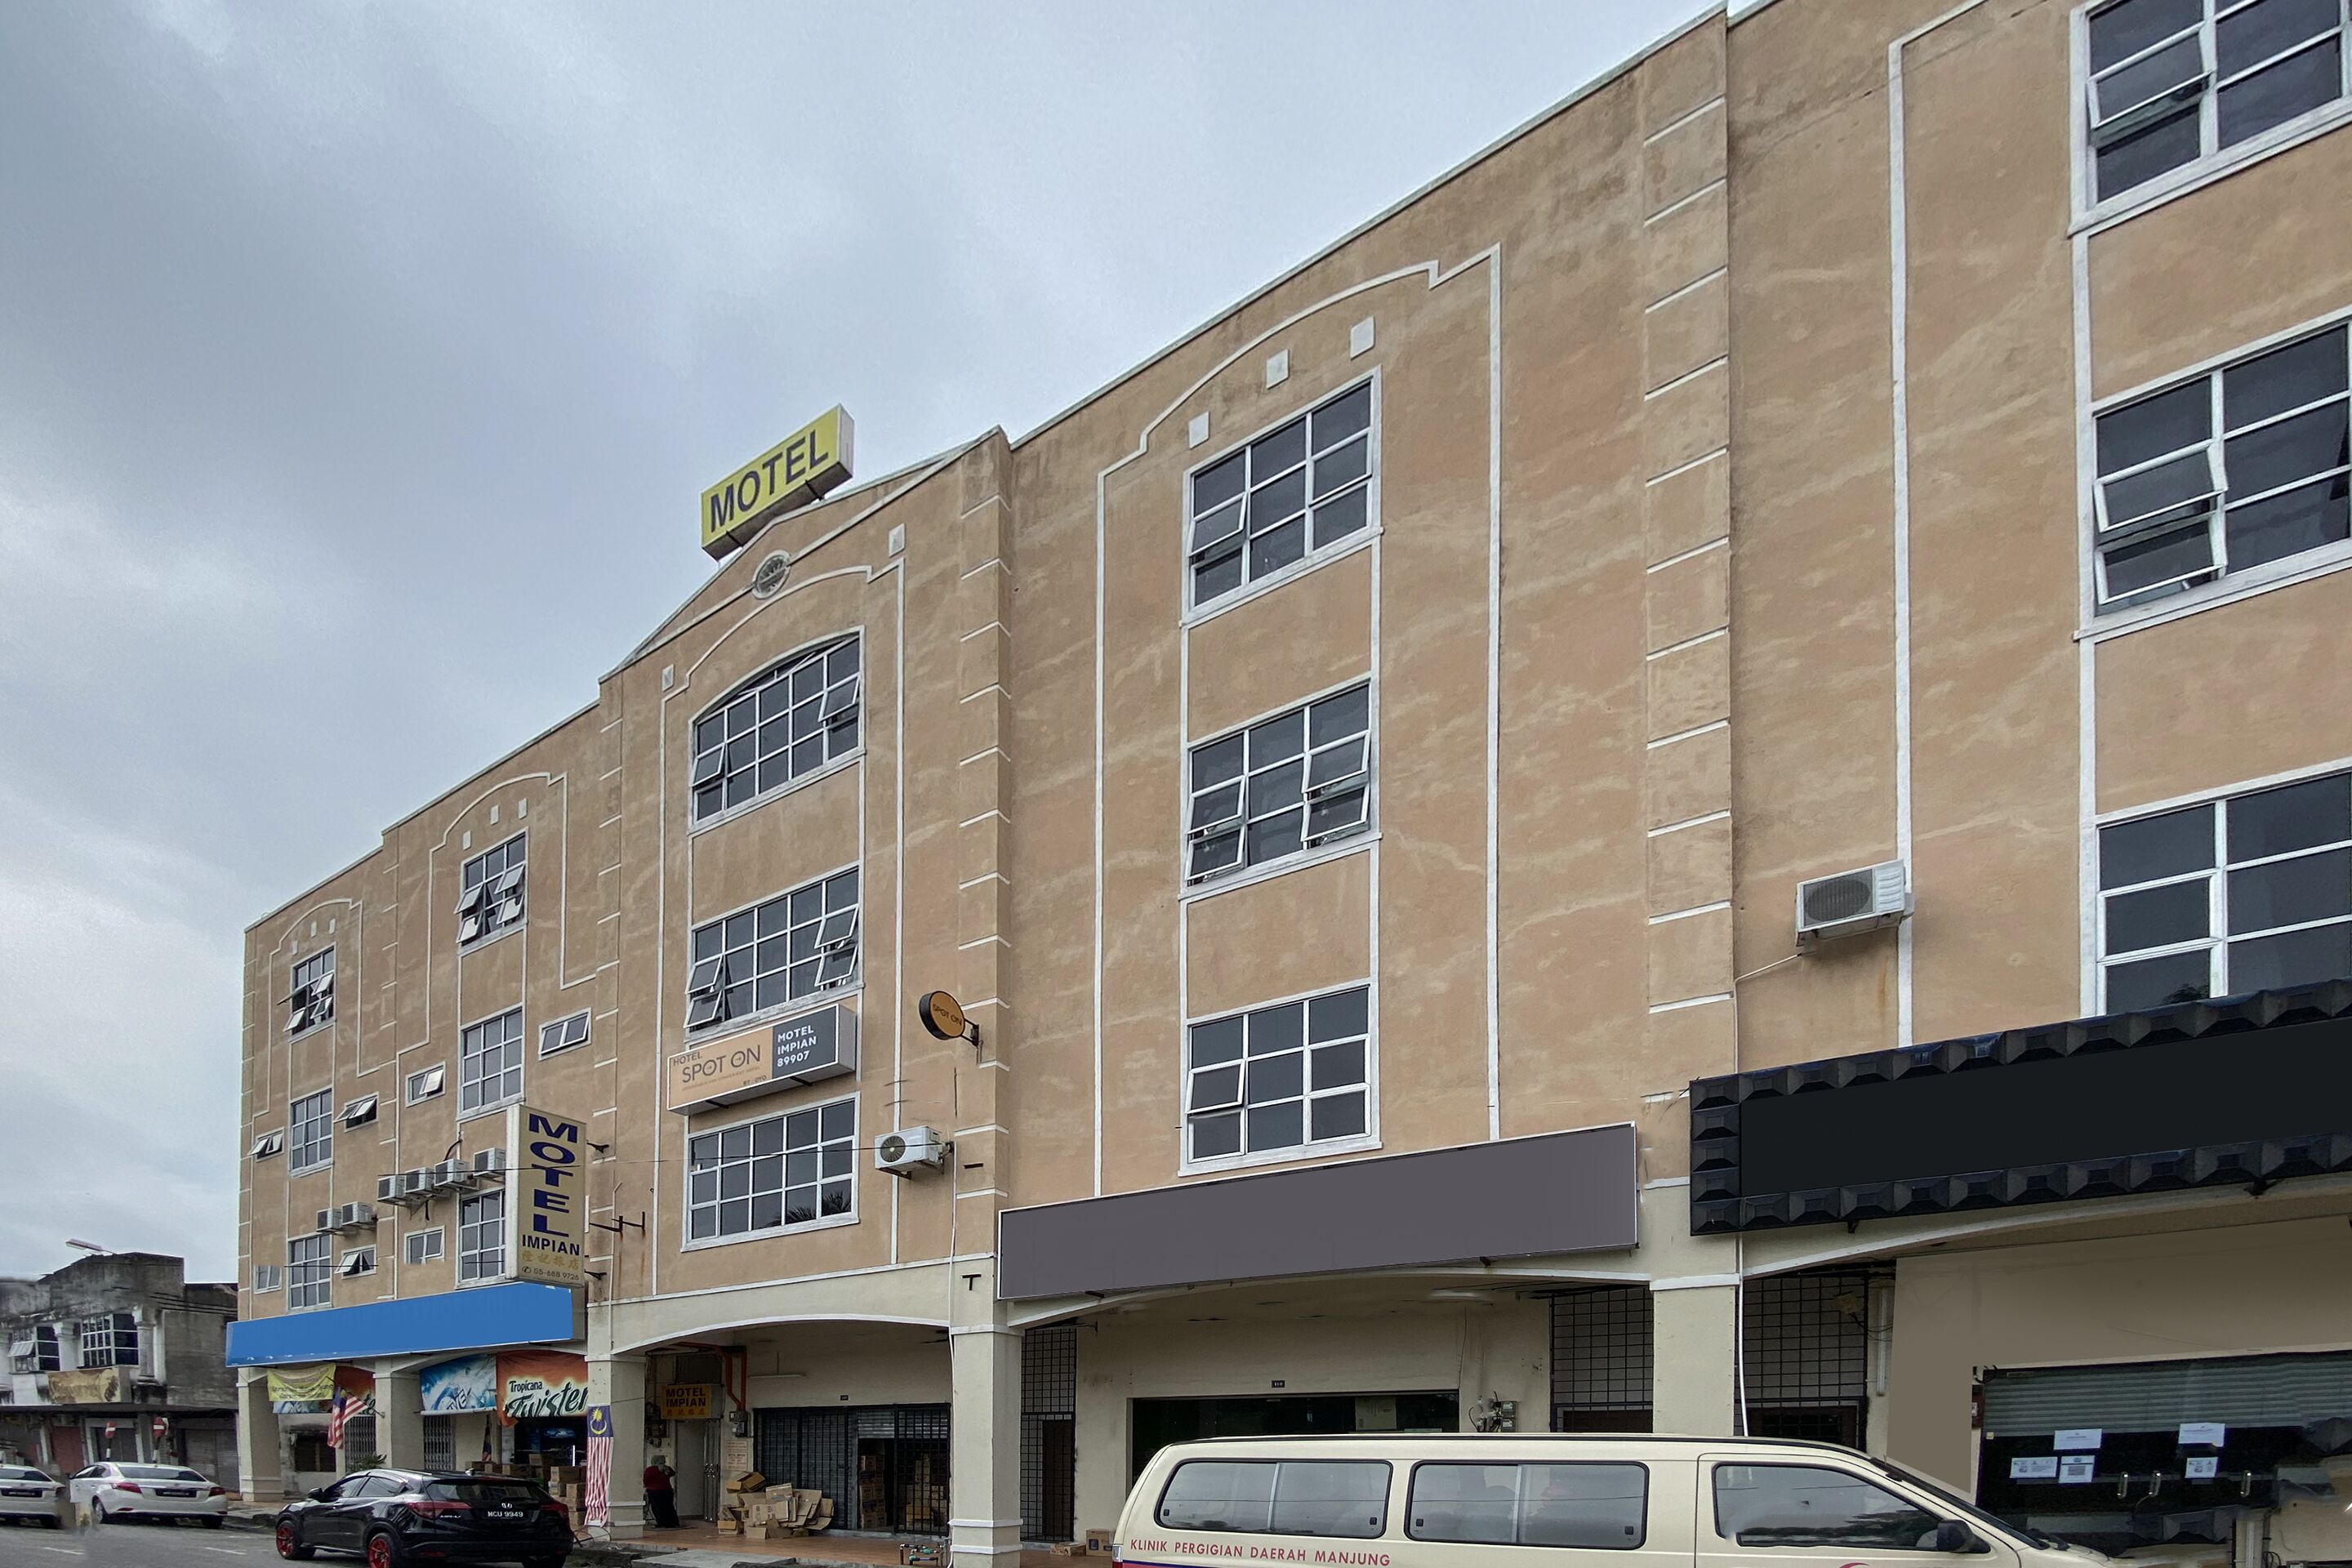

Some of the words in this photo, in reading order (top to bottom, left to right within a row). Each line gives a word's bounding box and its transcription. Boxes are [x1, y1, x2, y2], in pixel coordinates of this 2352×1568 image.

[710, 429, 829, 532] MOTEL
[777, 1024, 815, 1044] MOTEL
[777, 1035, 817, 1055] IMPIAN
[673, 1050, 703, 1067] HOTEL
[681, 1054, 727, 1084] SPOT
[730, 1045, 761, 1068] ON
[777, 1050, 811, 1067] 89907
[528, 1113, 578, 1237] MOTEL
[523, 1235, 580, 1256] IMPIAN
[509, 1379, 543, 1393] Tropicana
[666, 1388, 706, 1398] MOTEL
[666, 1397, 706, 1407] IMPIAN
[1130, 1539, 1168, 1552] KLINIK
[1174, 1541, 1243, 1557] PERGIGIAN
[1250, 1547, 1306, 1561] DAERAH
[1315, 1550, 1391, 1566] MANJUNG
